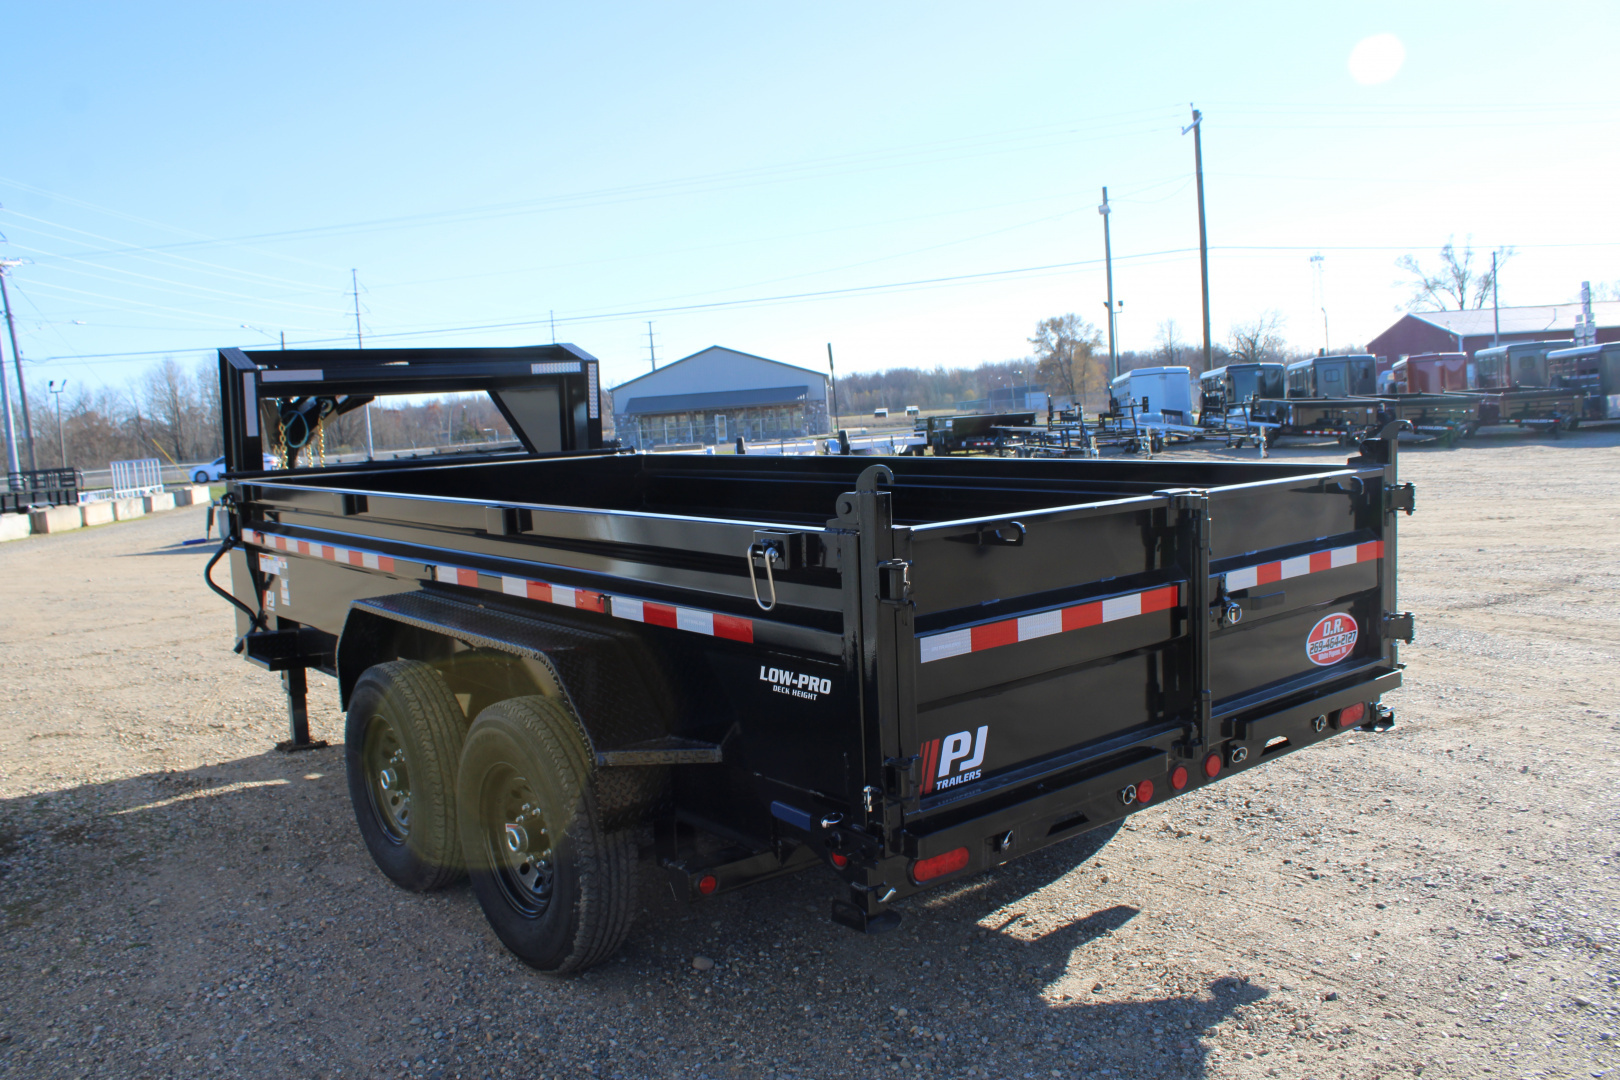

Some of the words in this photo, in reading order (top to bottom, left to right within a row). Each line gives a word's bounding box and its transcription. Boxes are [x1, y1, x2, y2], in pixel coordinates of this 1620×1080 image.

[1323, 618, 1344, 637] D.R.
[1309, 630, 1357, 654] 269-464-2127
[760, 665, 832, 695] LOW-PRO
[773, 684, 790, 695] DECK
[791, 688, 817, 701] HEIGHT
[938, 725, 988, 777] PJ
[936, 769, 981, 790] TRAILERS
